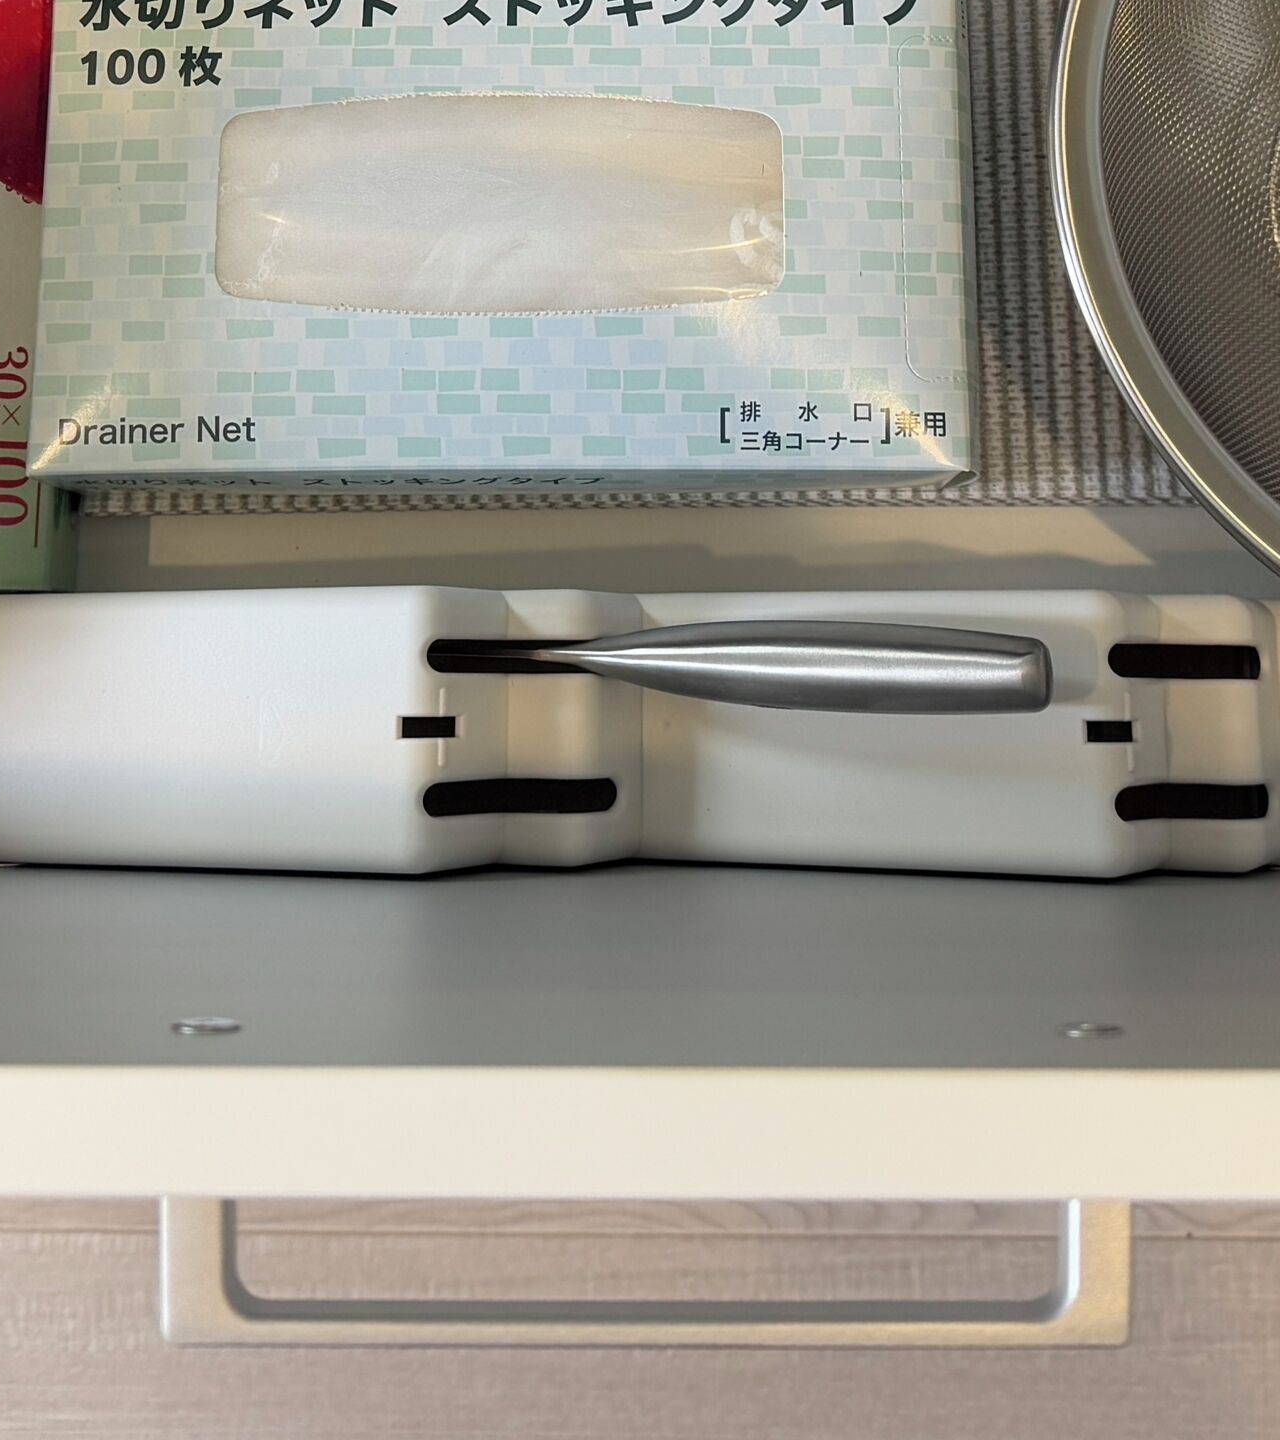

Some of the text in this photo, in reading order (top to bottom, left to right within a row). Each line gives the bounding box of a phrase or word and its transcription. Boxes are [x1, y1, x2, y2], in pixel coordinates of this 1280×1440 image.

[58, 414, 257, 446] Drainer Net
[740, 410, 947, 452] 三角コーナー 兼用
